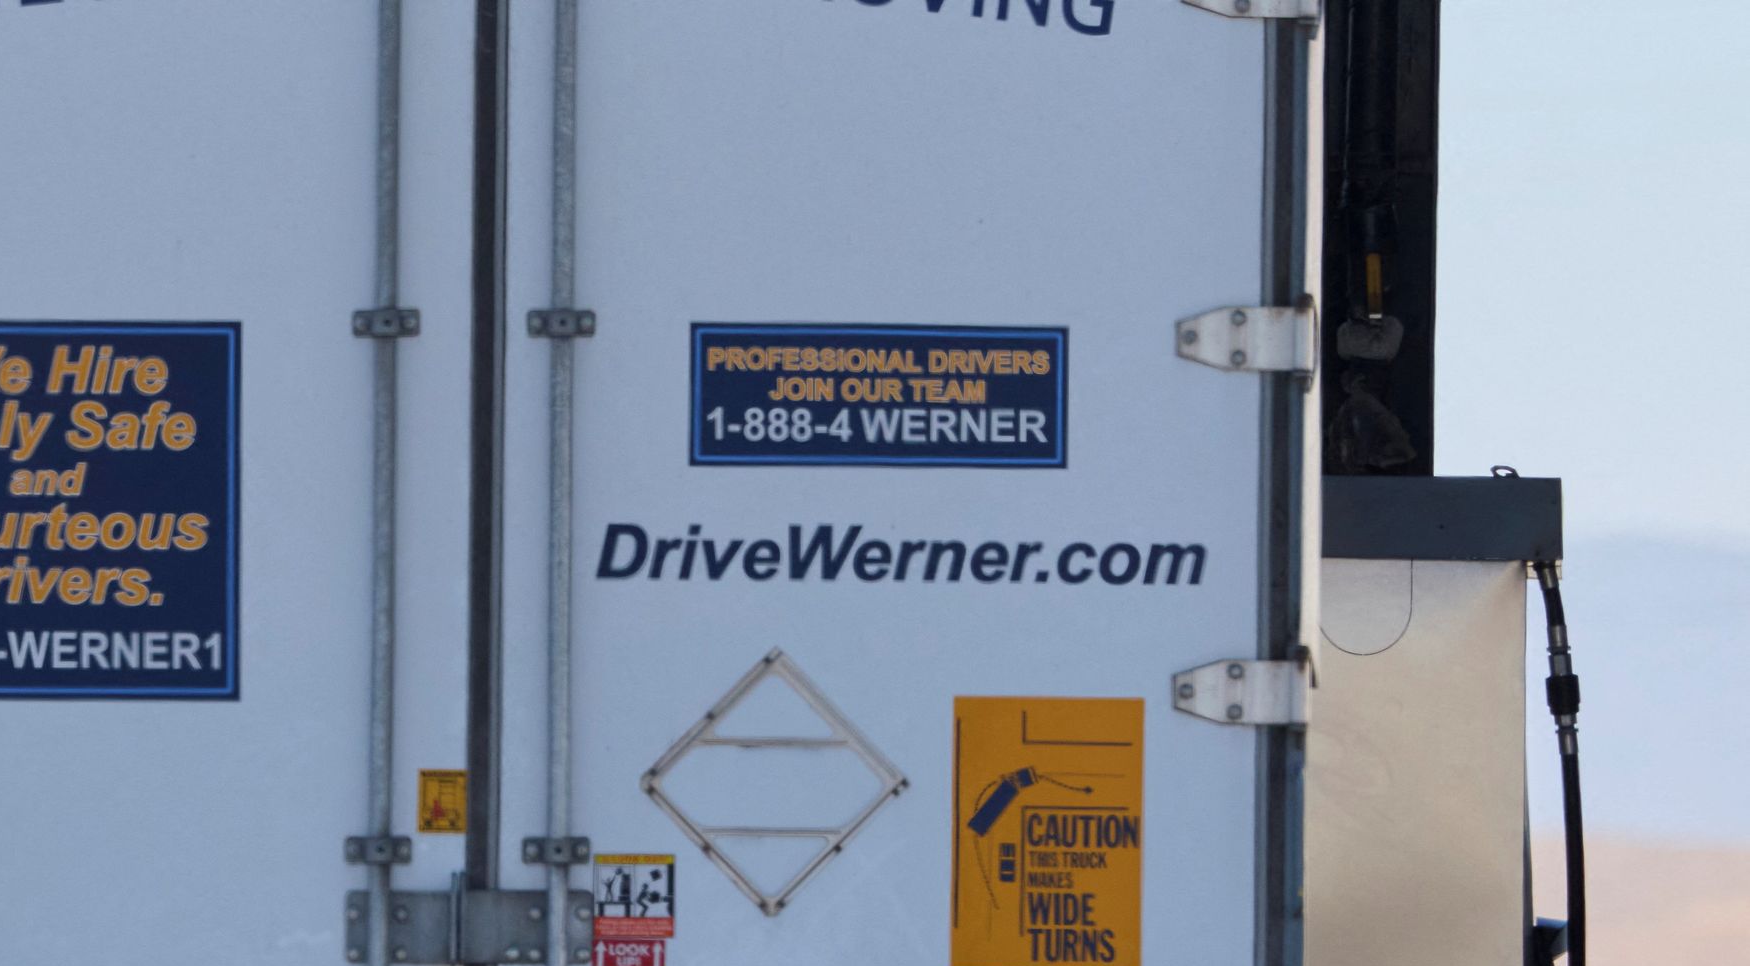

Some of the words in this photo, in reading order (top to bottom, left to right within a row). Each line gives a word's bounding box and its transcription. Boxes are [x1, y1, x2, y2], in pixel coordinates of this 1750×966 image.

[47, 345, 168, 394] Hire
[706, 347, 922, 373] PROFESSIONAL
[928, 349, 1050, 375] DRIVERS
[769, 377, 834, 401] JOIN
[841, 378, 904, 402] OUR
[910, 379, 986, 404] TEAM
[65, 400, 197, 450] Safe
[706, 406, 852, 443] 1-888-4
[861, 408, 1048, 444] WERNER
[9, 462, 87, 496] and
[595, 522, 1207, 586] DriveWerner.com
[1027, 813, 1140, 849] CAUTION
[1029, 851, 1058, 868] THIS
[1062, 852, 1107, 869] TRUCK
[1027, 871, 1074, 889] MAKES
[1027, 892, 1096, 926] WIDE
[608, 943, 651, 956] LOOK
[1027, 928, 1116, 963] TURNS
